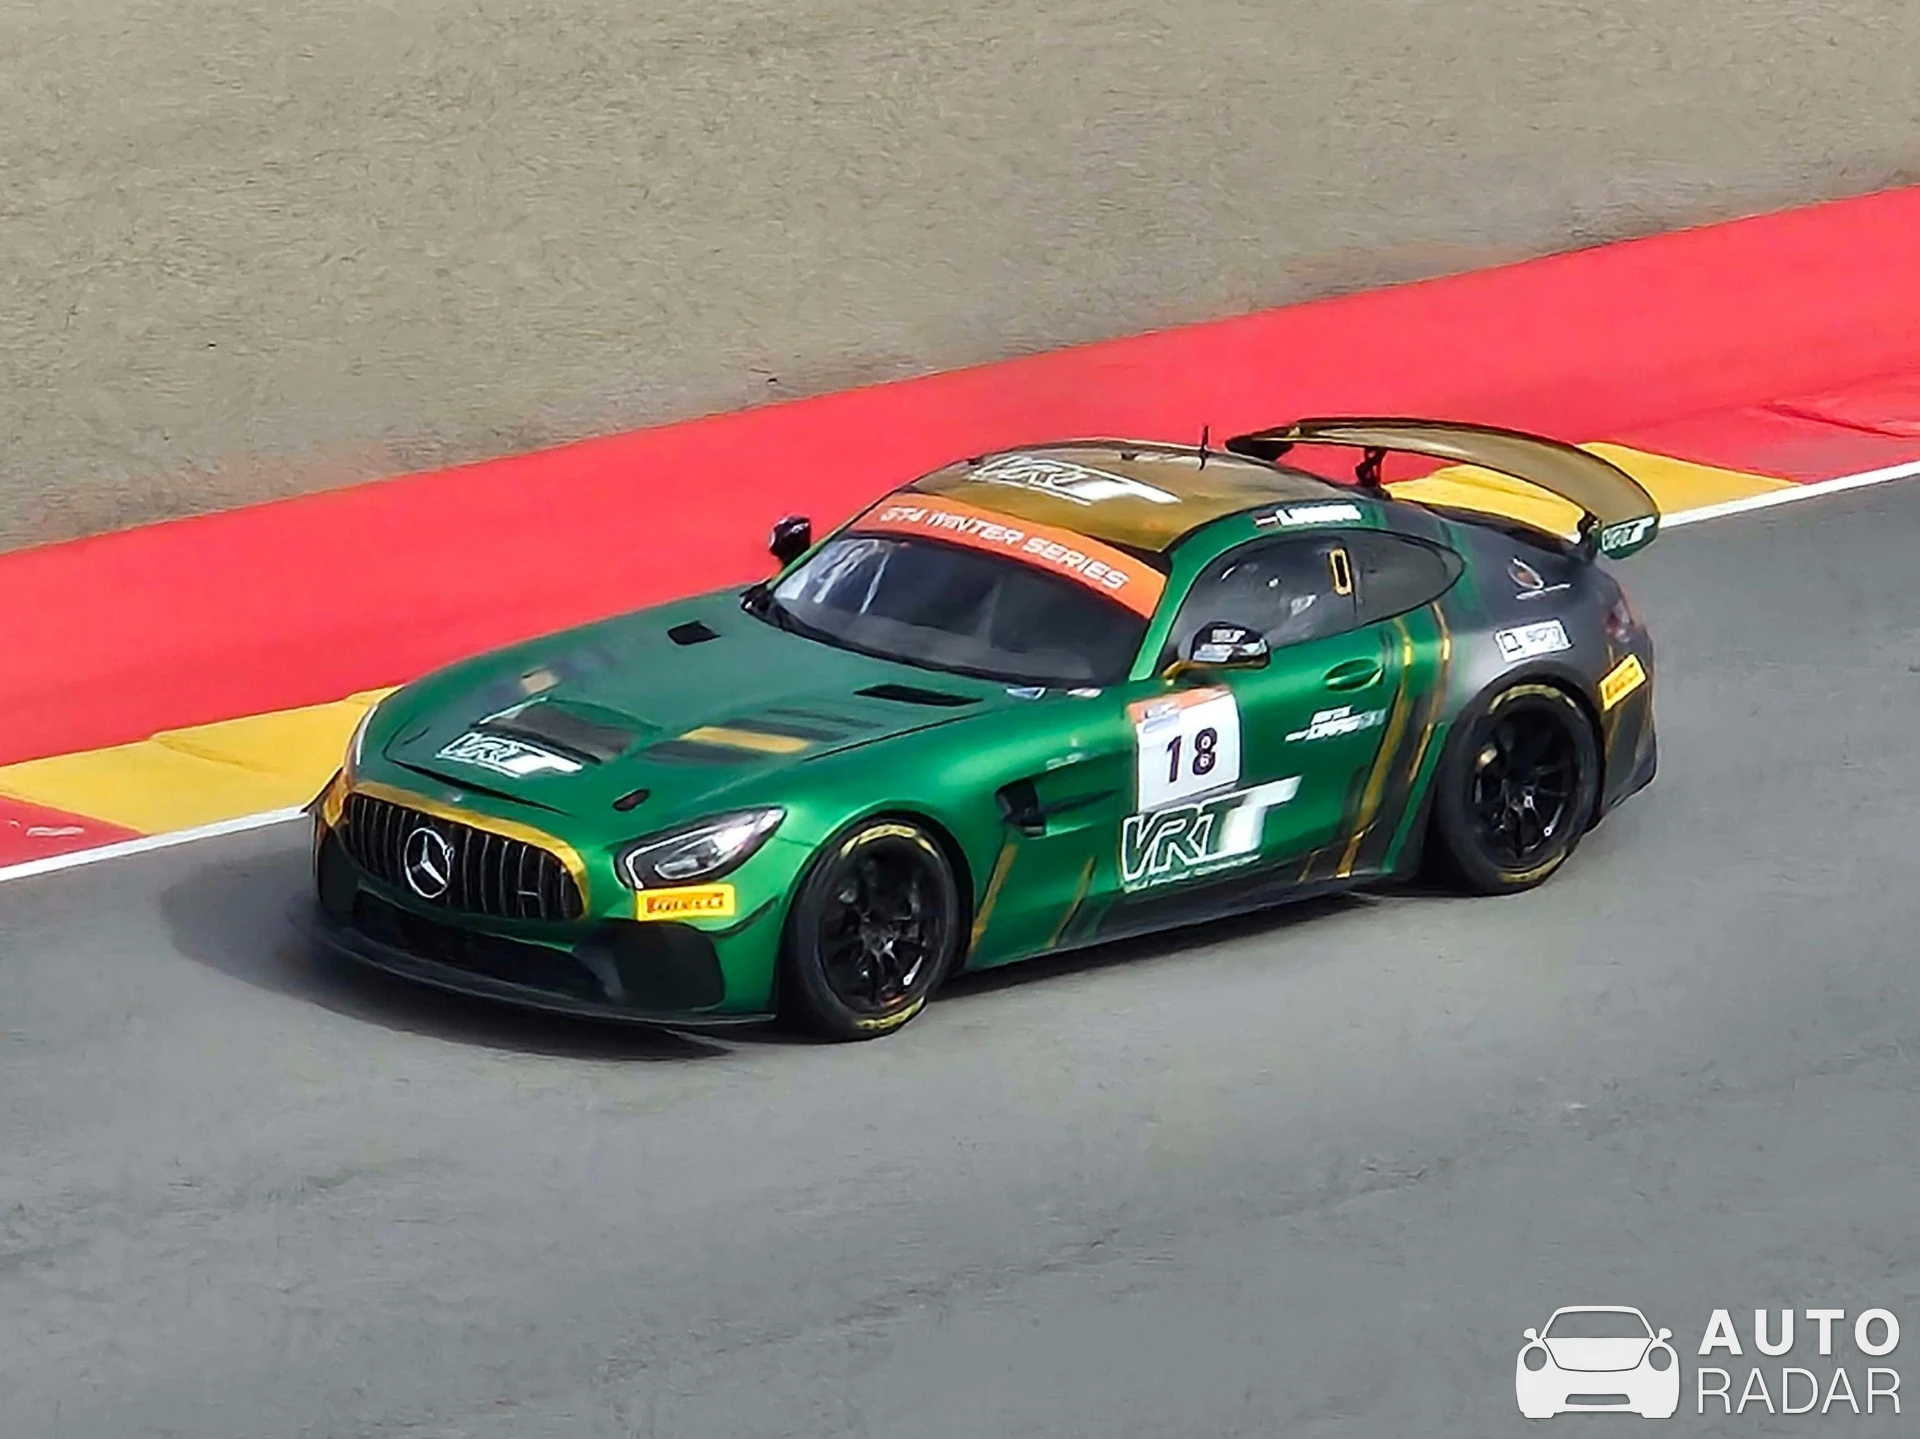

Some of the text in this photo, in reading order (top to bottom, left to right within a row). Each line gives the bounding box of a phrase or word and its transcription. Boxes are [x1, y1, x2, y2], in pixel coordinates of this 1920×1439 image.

[925, 512, 1025, 545] WINTER
[1022, 537, 1131, 590] SERIES
[1166, 727, 1218, 784] 18
[1120, 774, 1303, 881] VRT
